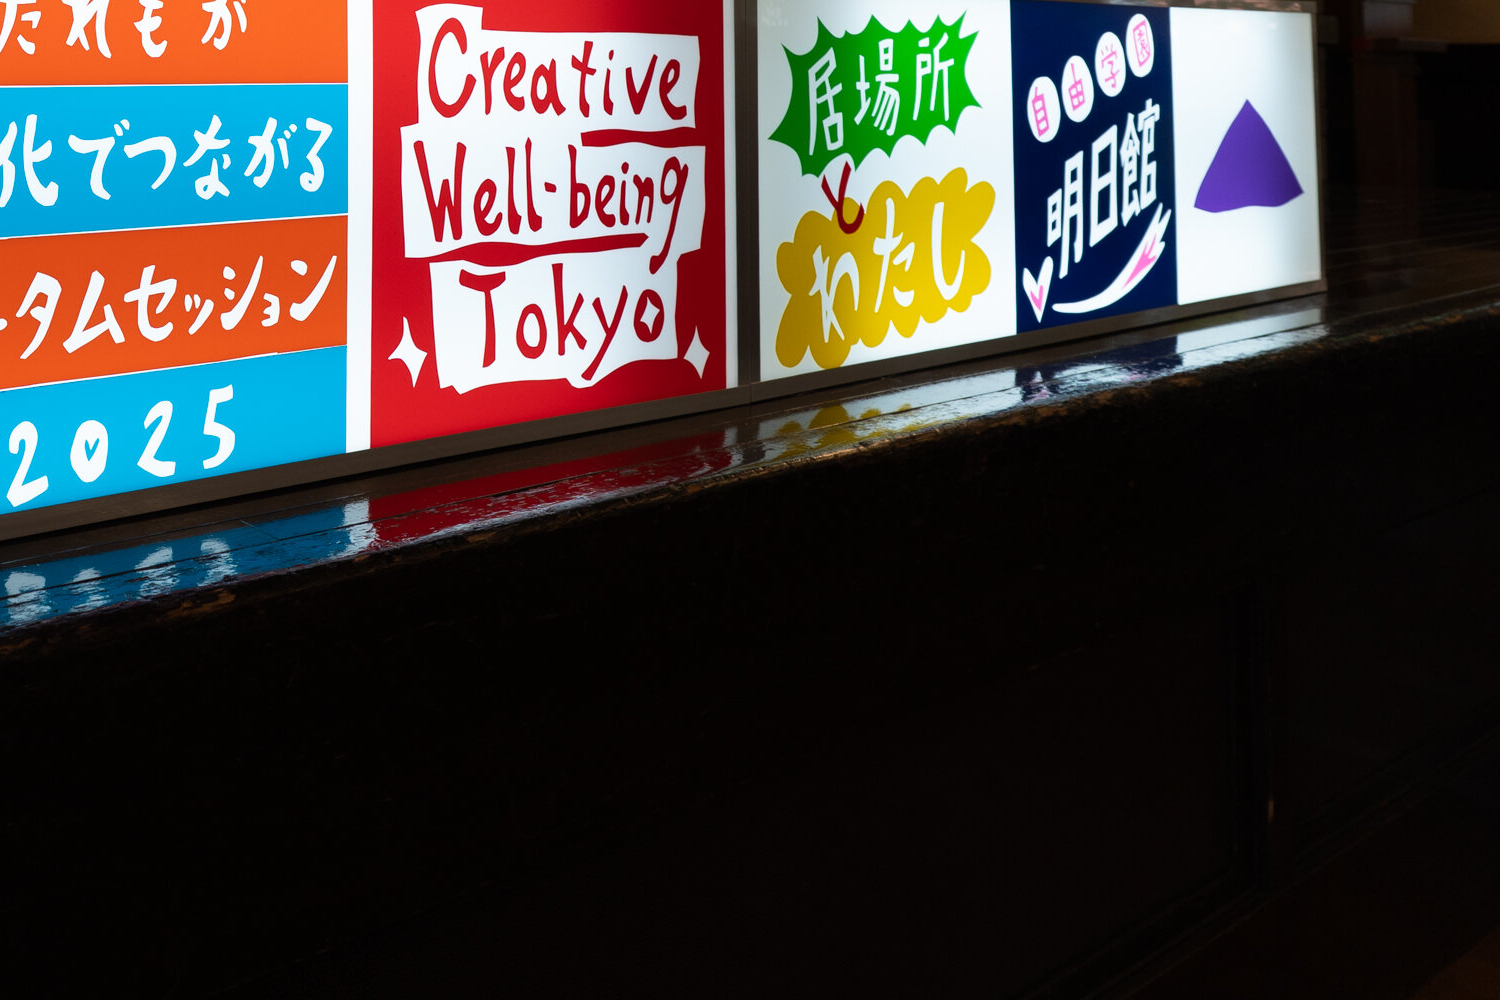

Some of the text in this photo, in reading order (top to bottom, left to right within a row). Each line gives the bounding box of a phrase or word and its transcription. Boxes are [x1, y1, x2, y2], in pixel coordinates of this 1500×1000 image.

[428, 17, 688, 120] Creative
[807, 32, 955, 156] 居場所
[1031, 18, 1152, 138] 自由学園
[413, 137, 688, 275] Well-being
[1047, 97, 1160, 280] 明日館
[459, 263, 665, 381] Tokyo
[808, 197, 966, 344] わたし
[6, 384, 236, 508] 2025
